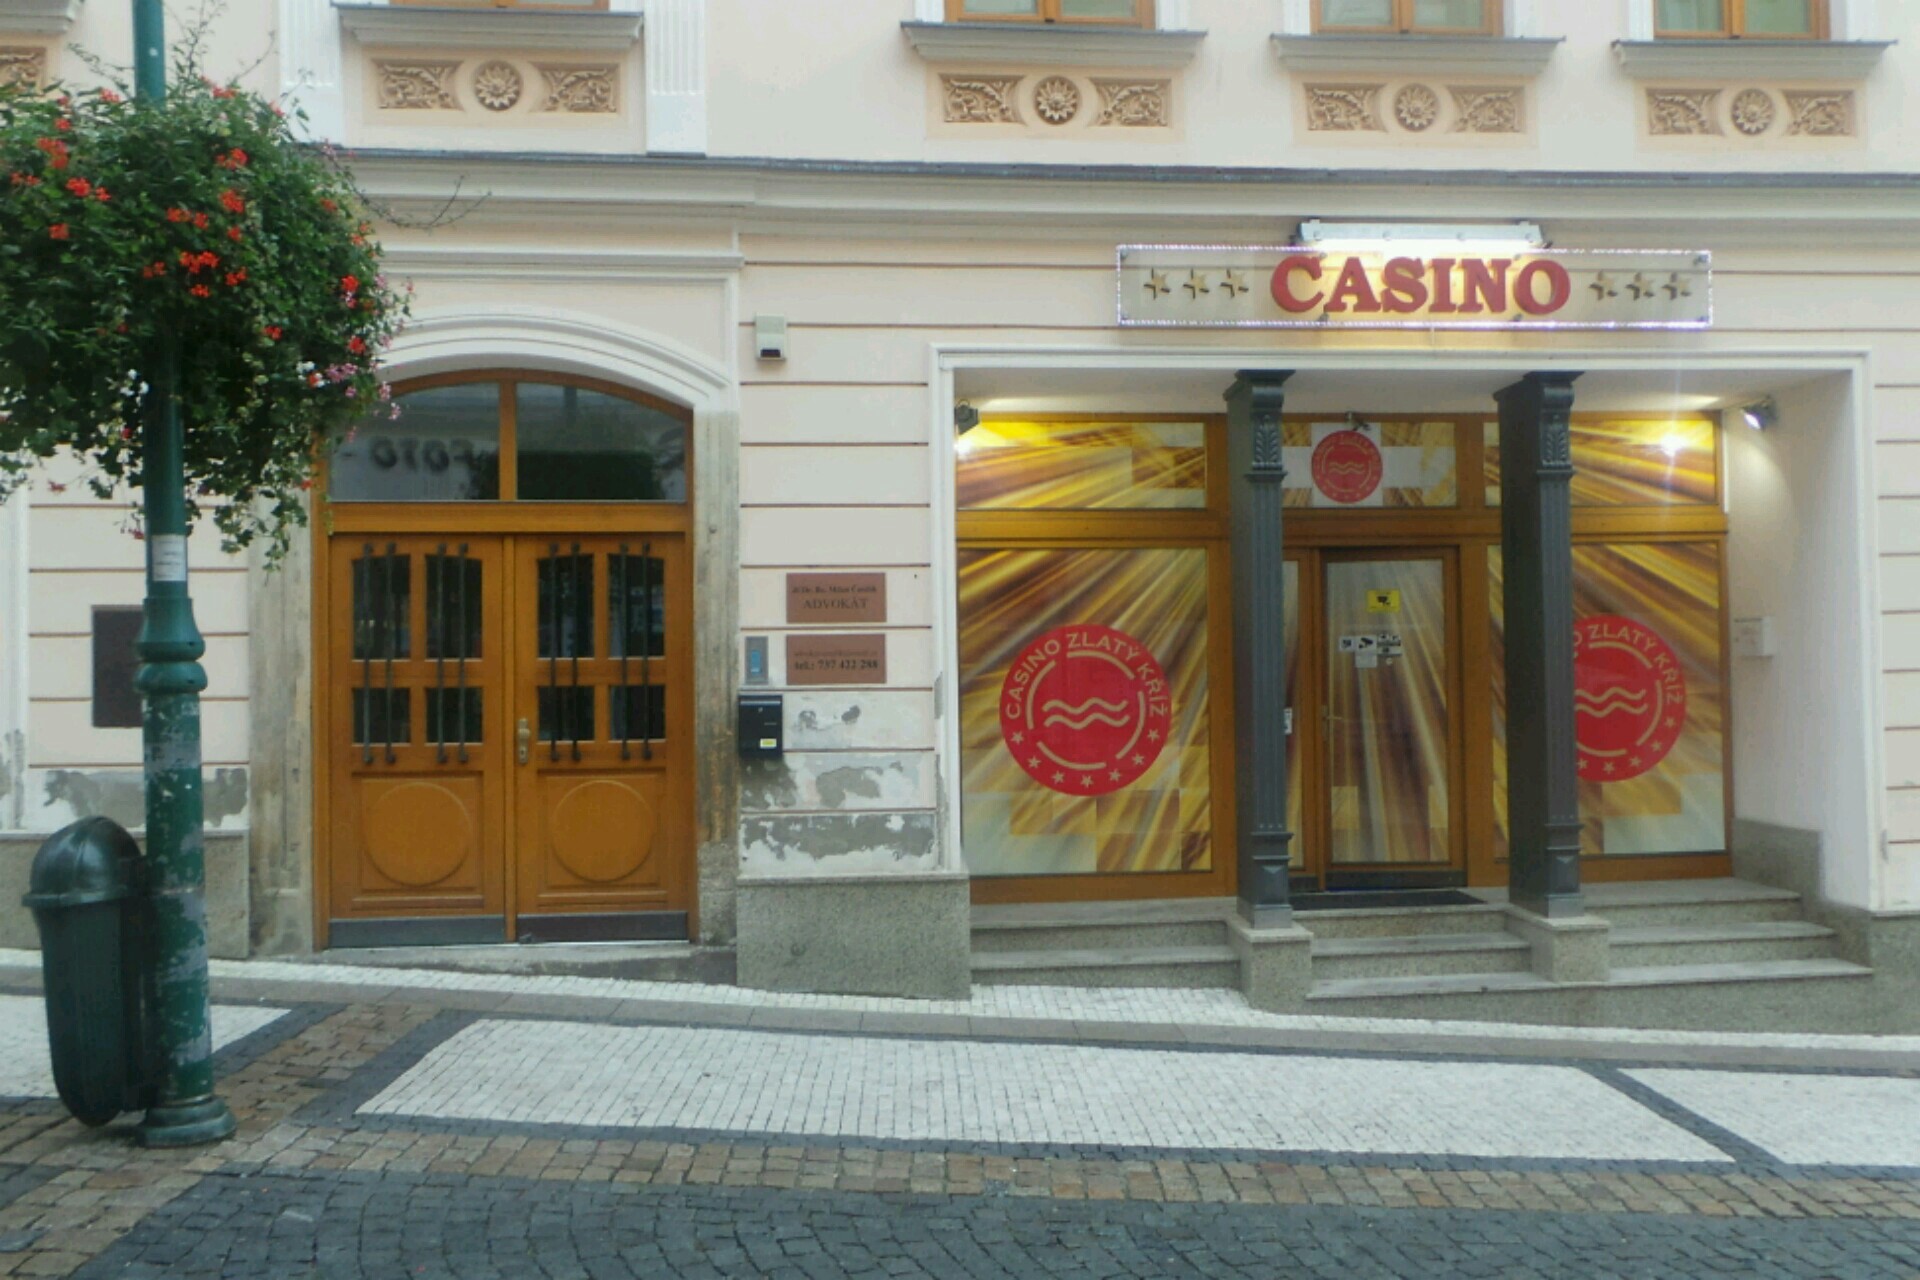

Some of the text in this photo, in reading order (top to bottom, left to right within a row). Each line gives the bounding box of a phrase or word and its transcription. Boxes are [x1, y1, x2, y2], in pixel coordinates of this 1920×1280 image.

[1270, 254, 1571, 315] CASINO
[803, 596, 868, 610] ADVOKÁT
[1005, 631, 1169, 720] CASINO ZLATÝ KŘÍŽ
